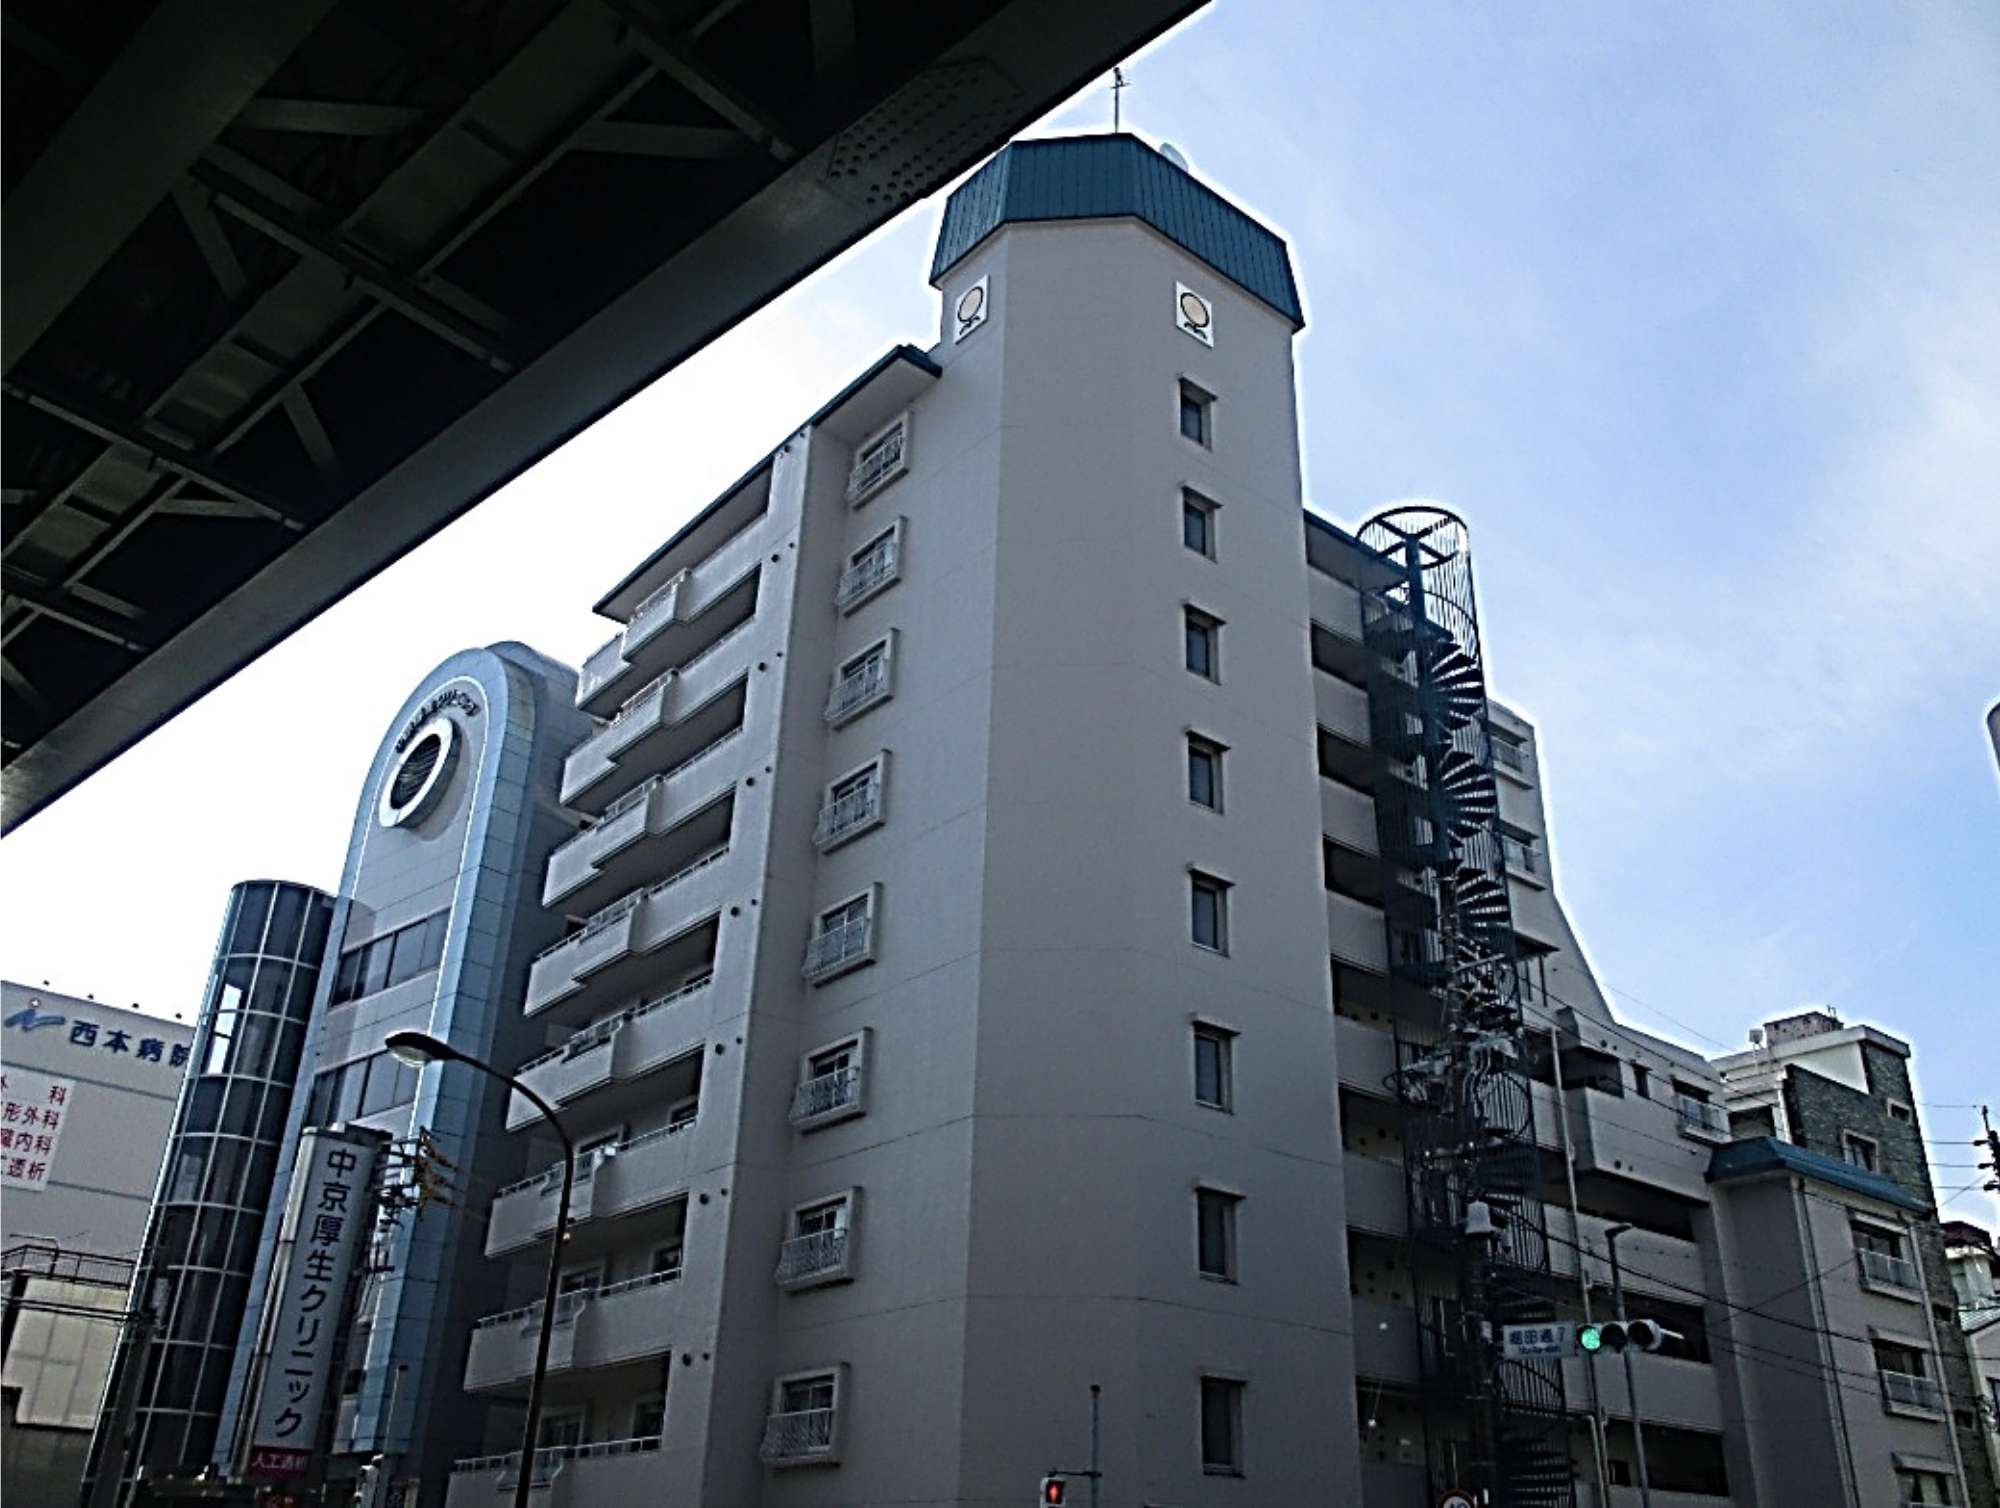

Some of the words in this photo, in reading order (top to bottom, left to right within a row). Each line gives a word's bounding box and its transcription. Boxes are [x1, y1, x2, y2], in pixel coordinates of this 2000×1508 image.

[69, 1019, 192, 1067] 西本病院
[0, 1101, 60, 1131] 形外科
[274, 1148, 357, 1438] 中京厚生クリニック
